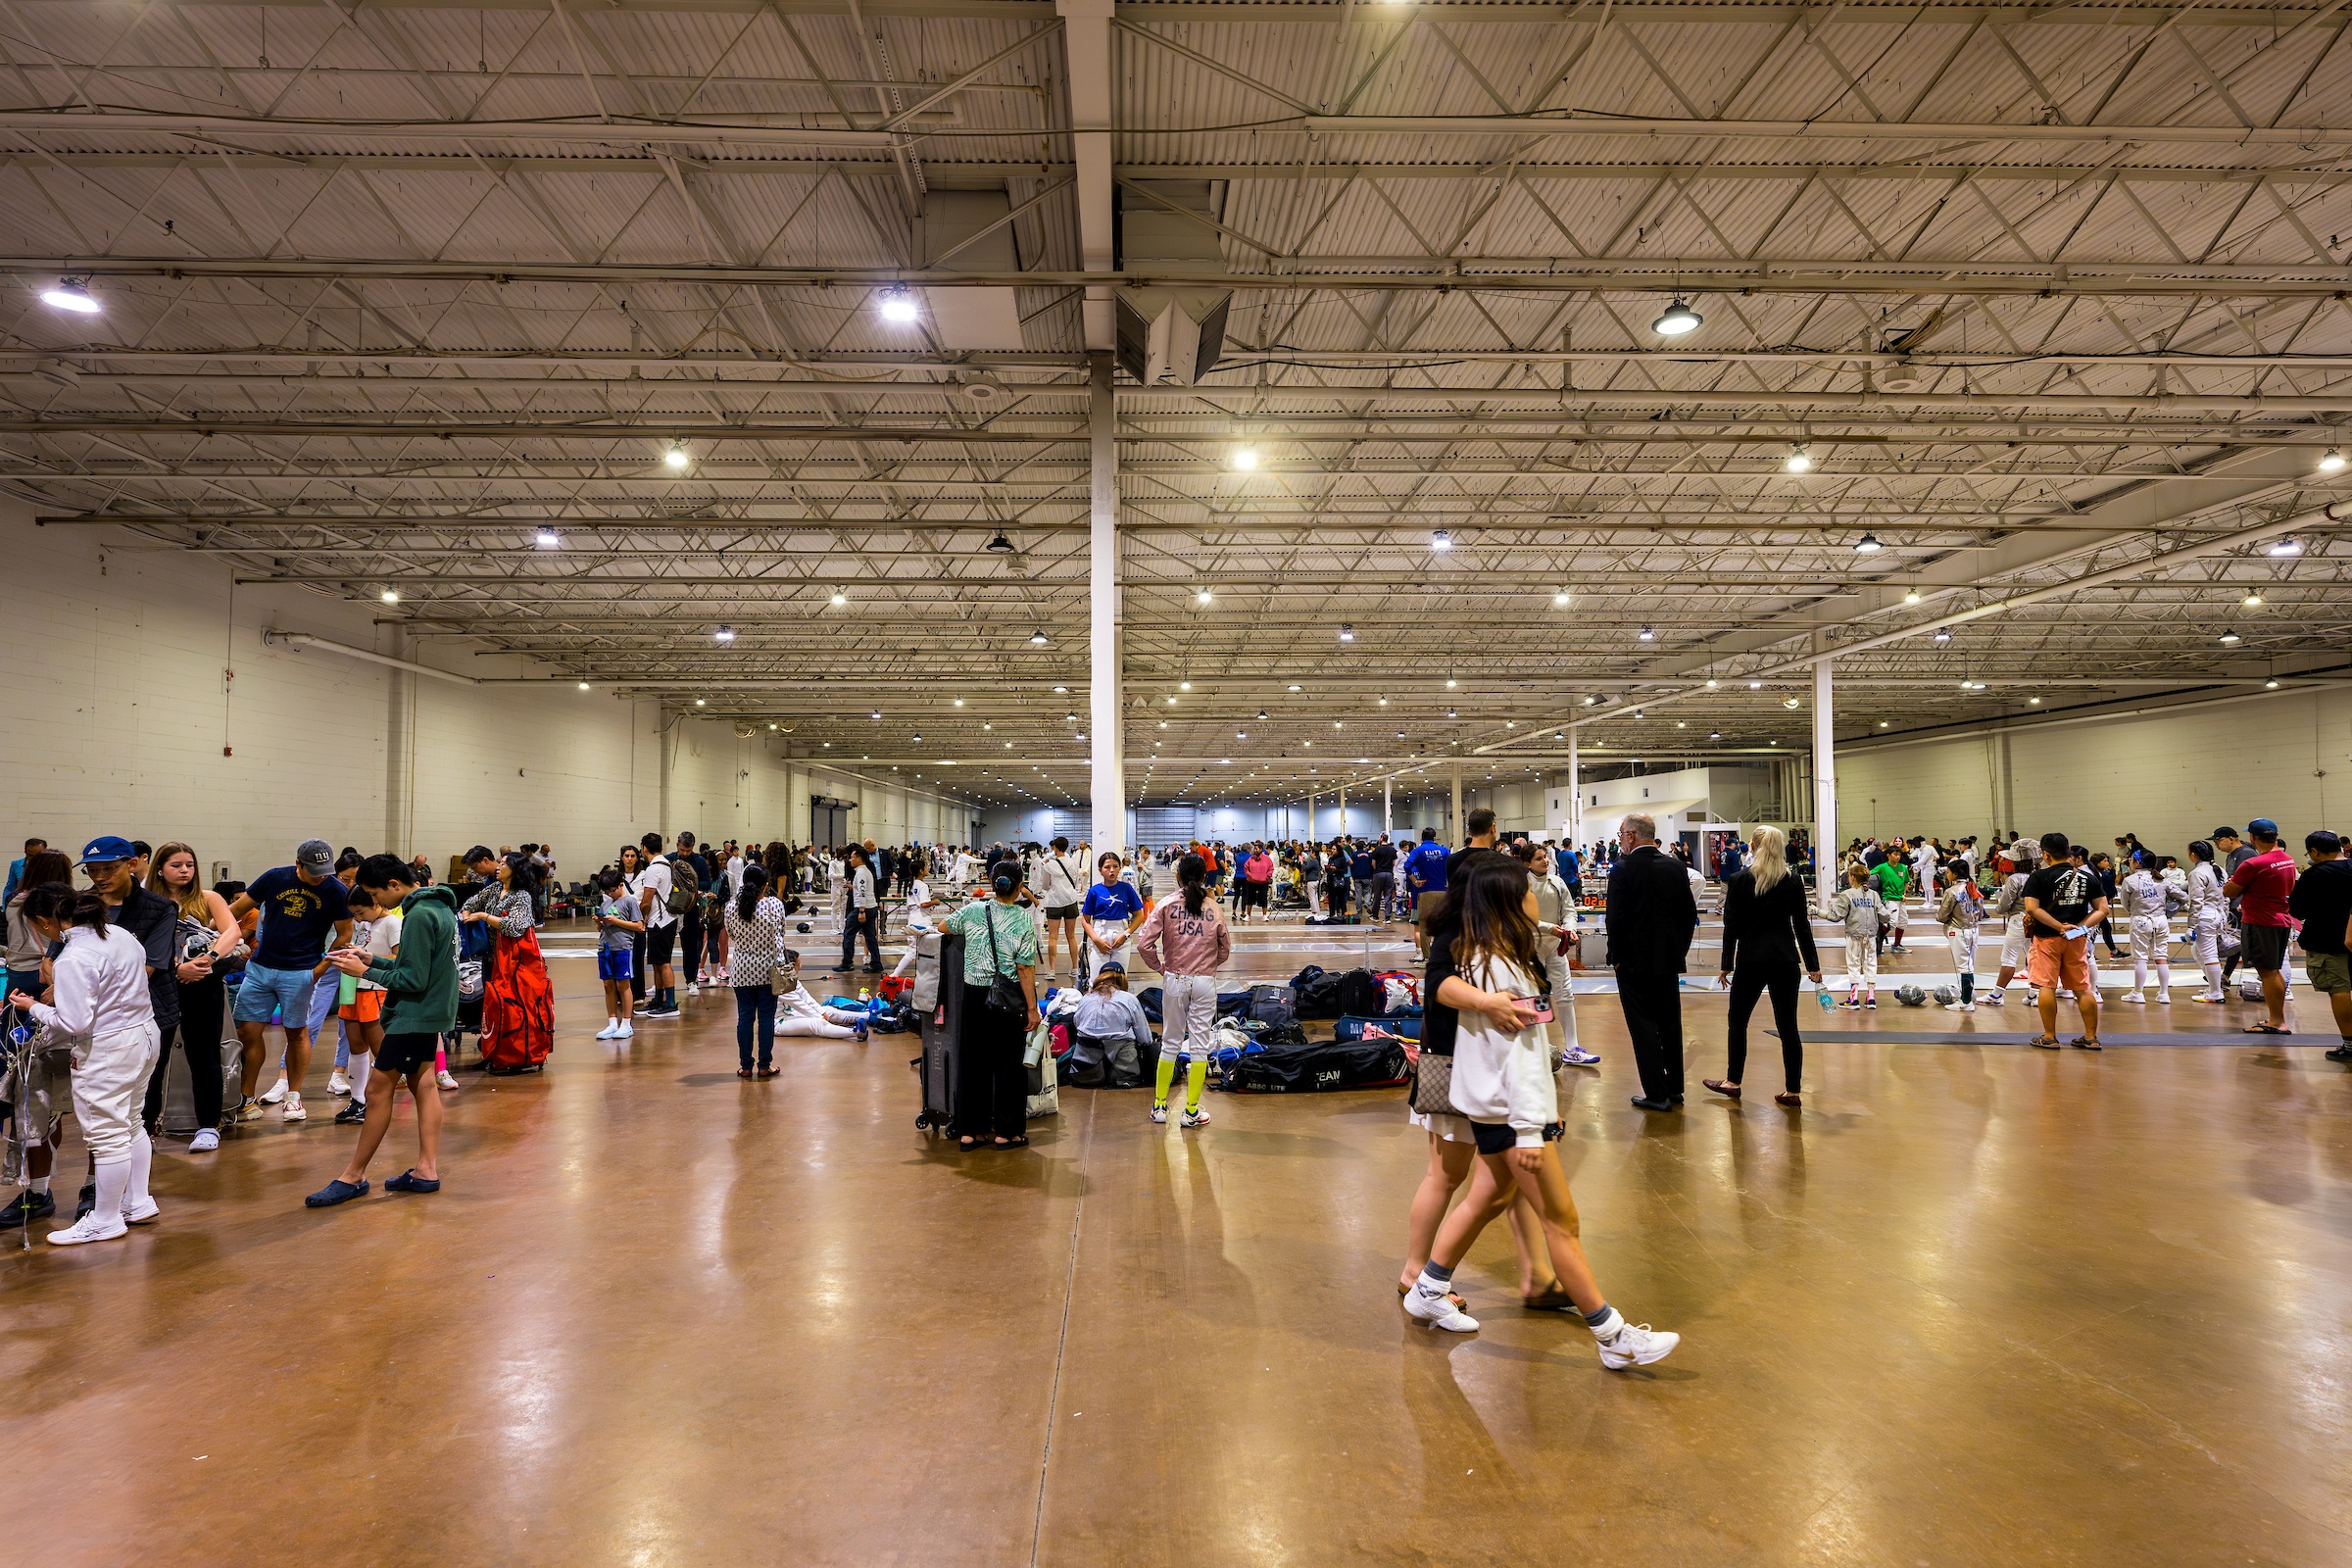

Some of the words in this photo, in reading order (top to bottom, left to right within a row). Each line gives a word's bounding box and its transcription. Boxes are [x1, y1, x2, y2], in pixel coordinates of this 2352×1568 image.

[2141, 888, 2159, 899] USA
[1177, 920, 1204, 937] USA
[1246, 1082, 1287, 1093] ABSOUTE
